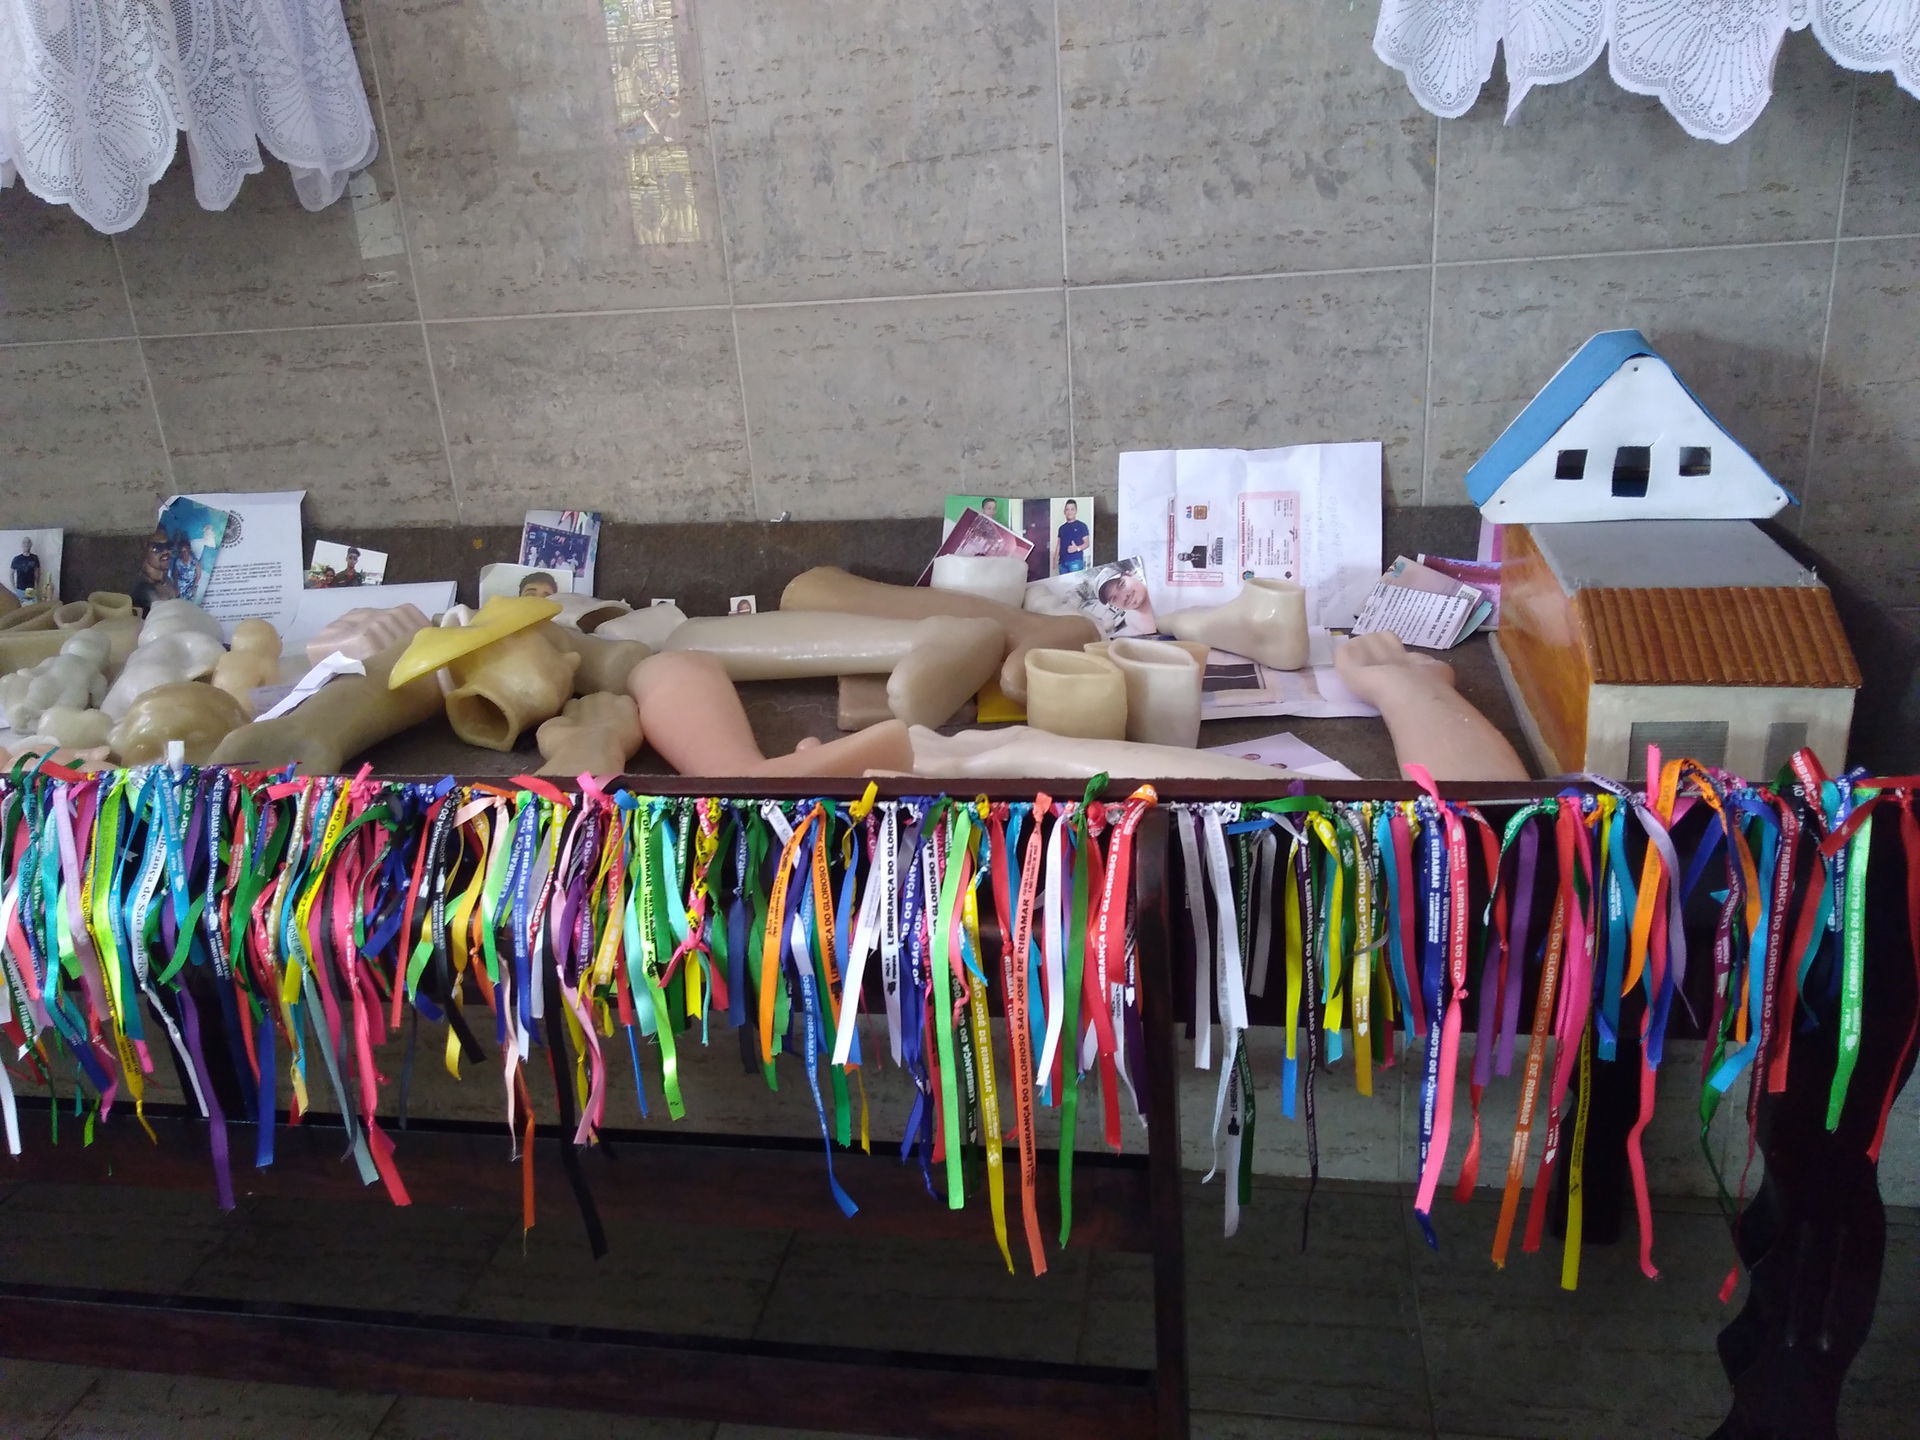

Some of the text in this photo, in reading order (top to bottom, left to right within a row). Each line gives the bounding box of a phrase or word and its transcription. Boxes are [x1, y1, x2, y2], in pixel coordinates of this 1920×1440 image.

[212, 791, 221, 802] DE
[426, 808, 450, 869] LEMBRANÇA DO
[525, 835, 532, 849] DE
[643, 819, 650, 834] DE
[677, 816, 689, 864] RIBAMAR
[500, 837, 525, 898] LEMBRANÇA
[517, 851, 530, 899] RIBAMAR
[887, 860, 894, 875] DO
[1431, 839, 1440, 889] RIBAMAR
[142, 886, 152, 900] de
[207, 869, 216, 902] PEDIDOS
[928, 861, 939, 917] GLORIOSO
[1102, 853, 1118, 912] GLORIOSO
[136, 903, 146, 925] São
[816, 845, 839, 979] LEMBRANÇA DO GLORIOSO SÃO
[887, 878, 895, 946] LEMBRANÇA
[904, 901, 912, 919] DO
[1304, 879, 1313, 941] LEMBRANÇA
[1358, 897, 1366, 913] DO
[1454, 880, 1465, 942] LEMBRANÇA
[1017, 898, 1029, 954] RIBAMAR
[1099, 915, 1107, 932] DO
[1773, 915, 1782, 930] DO
[911, 941, 920, 966] SÃO
[1305, 942, 1312, 957] DO
[1455, 944, 1463, 958] DO
[1550, 933, 1560, 950] DO
[1849, 912, 1861, 999] LEMBRANÇA DO
[1017, 957, 1024, 973] DE
[1766, 933, 1779, 993] GLORIOSO
[1016, 976, 1024, 1004] JOSÉ
[1306, 959, 1315, 1010] GLORIOSO
[1539, 952, 1556, 1008] GLORIOSO
[805, 998, 812, 1012] DE
[975, 1001, 986, 1027] JOSÉ
[1016, 1008, 1024, 1031] SÃO
[806, 1015, 814, 1064] RIBAMAR
[978, 1030, 987, 1043] DE
[960, 1028, 975, 1103] LEMBRANÇA DO
[980, 1046, 992, 1093] RIBAMAR
[1018, 1033, 1028, 1085] GLORIOSO
[1429, 1059, 1437, 1073] DO
[1528, 1063, 1538, 1077] DE
[1021, 1088, 1029, 1102] DO
[1423, 1075, 1437, 1136] LEMBRANÇA
[1519, 1079, 1536, 1125] RIBAMAR
[1021, 1105, 1033, 1167] LEMBRANÇA
